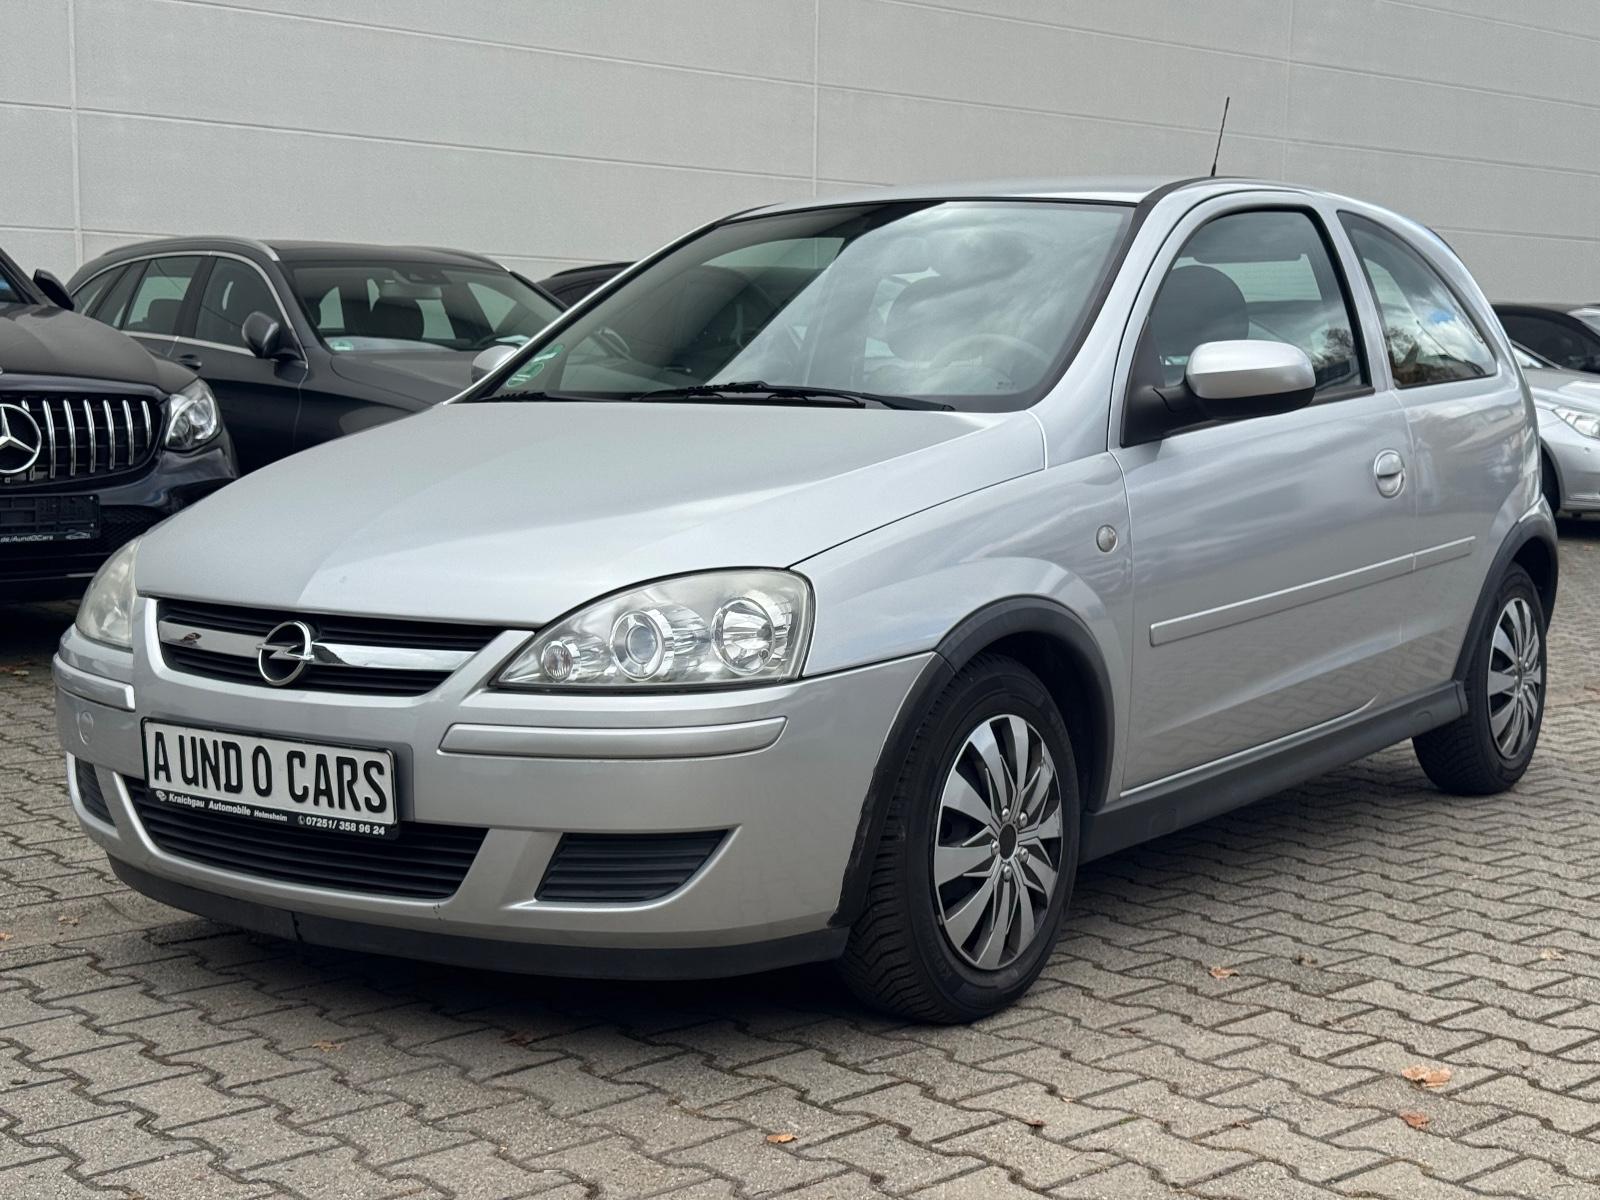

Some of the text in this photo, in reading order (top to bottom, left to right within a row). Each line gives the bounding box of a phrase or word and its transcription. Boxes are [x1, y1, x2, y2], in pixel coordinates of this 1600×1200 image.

[154, 731, 387, 813] A UND O CARS
[168, 793, 205, 808] Kraichgau
[208, 800, 251, 816] Automobile
[306, 816, 385, 836] 07251/ 358 96 24
